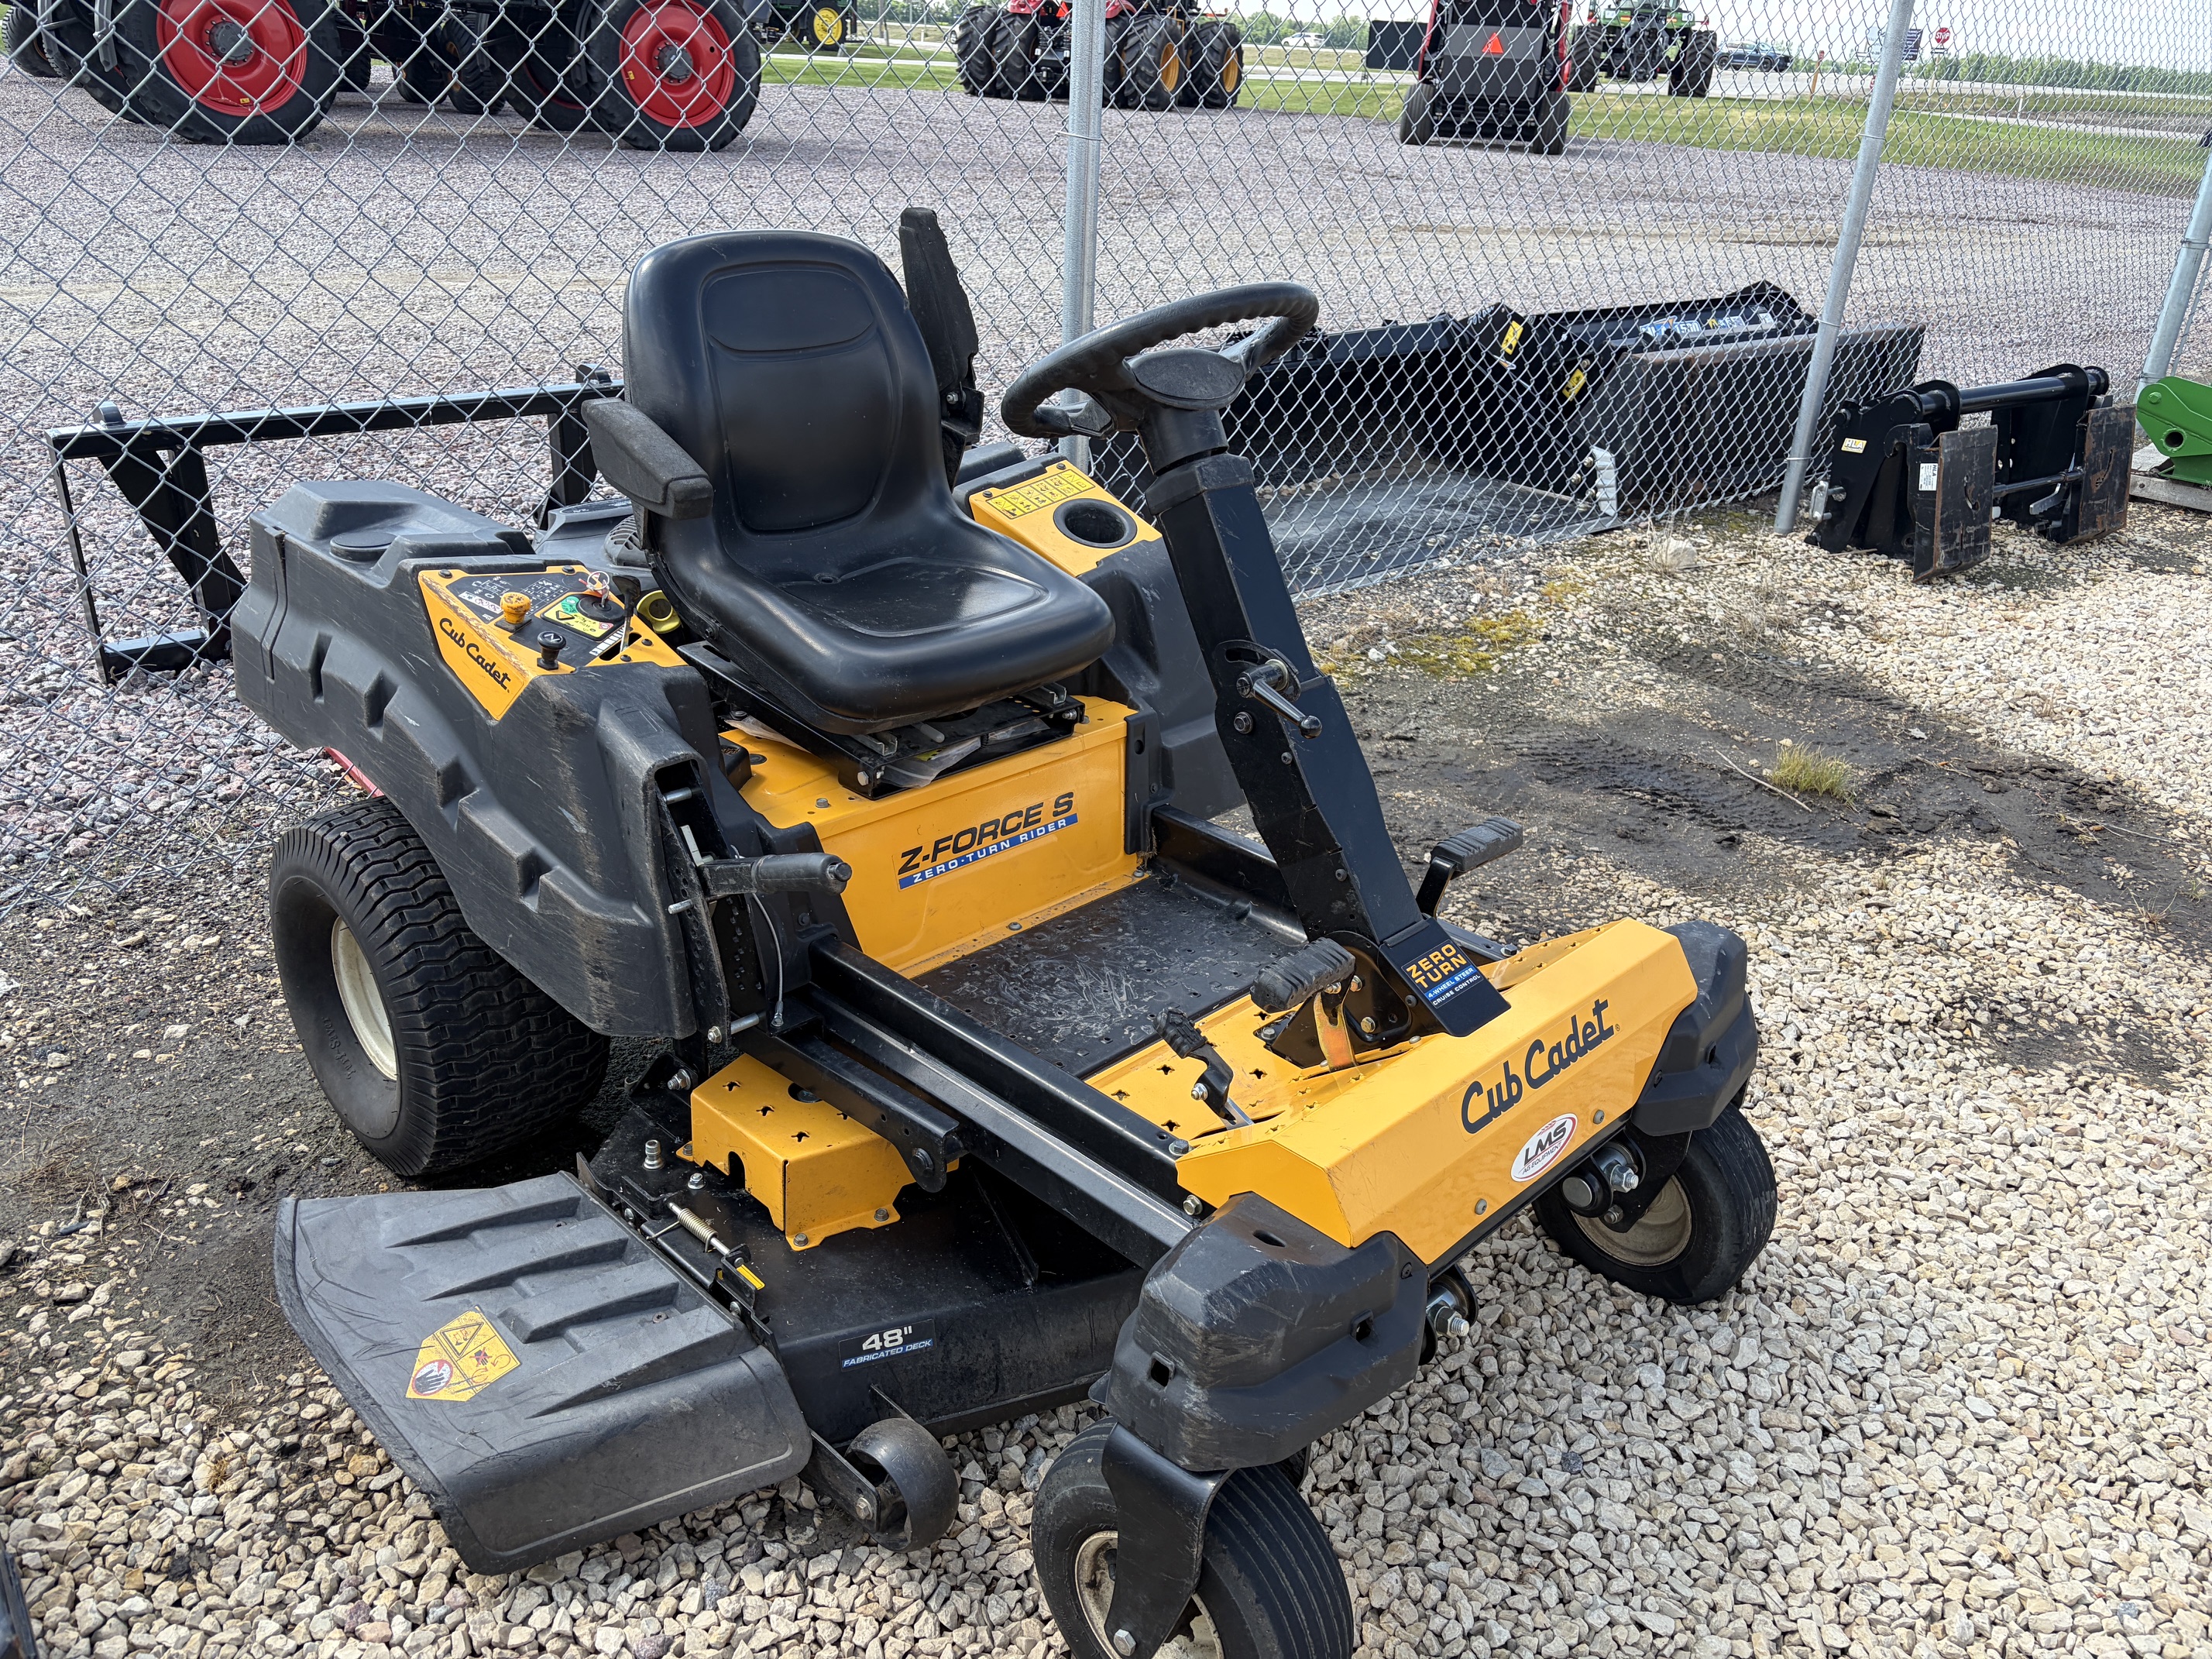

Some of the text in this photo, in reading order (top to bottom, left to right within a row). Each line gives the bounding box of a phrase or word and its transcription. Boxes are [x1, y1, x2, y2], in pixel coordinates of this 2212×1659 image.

[1844, 438, 1863, 449] HLA
[439, 617, 511, 691] Cub Cadet
[897, 792, 1074, 875] Z-FORCE S
[1019, 819, 1066, 843] RIDER
[1406, 943, 1456, 979] ZERO
[1414, 953, 1467, 988] TURN
[1427, 967, 1475, 998] 4-WHEEL STEER
[1432, 974, 1481, 1006] CRUISE CONTROL
[1461, 999, 1615, 1134] Cub Cadet
[1522, 1141, 1562, 1175] AG EQUIPMENT
[1523, 1119, 1567, 1166] LMS
[843, 1339, 932, 1367] FABRICATED DECK
[862, 1325, 912, 1351] 48"
